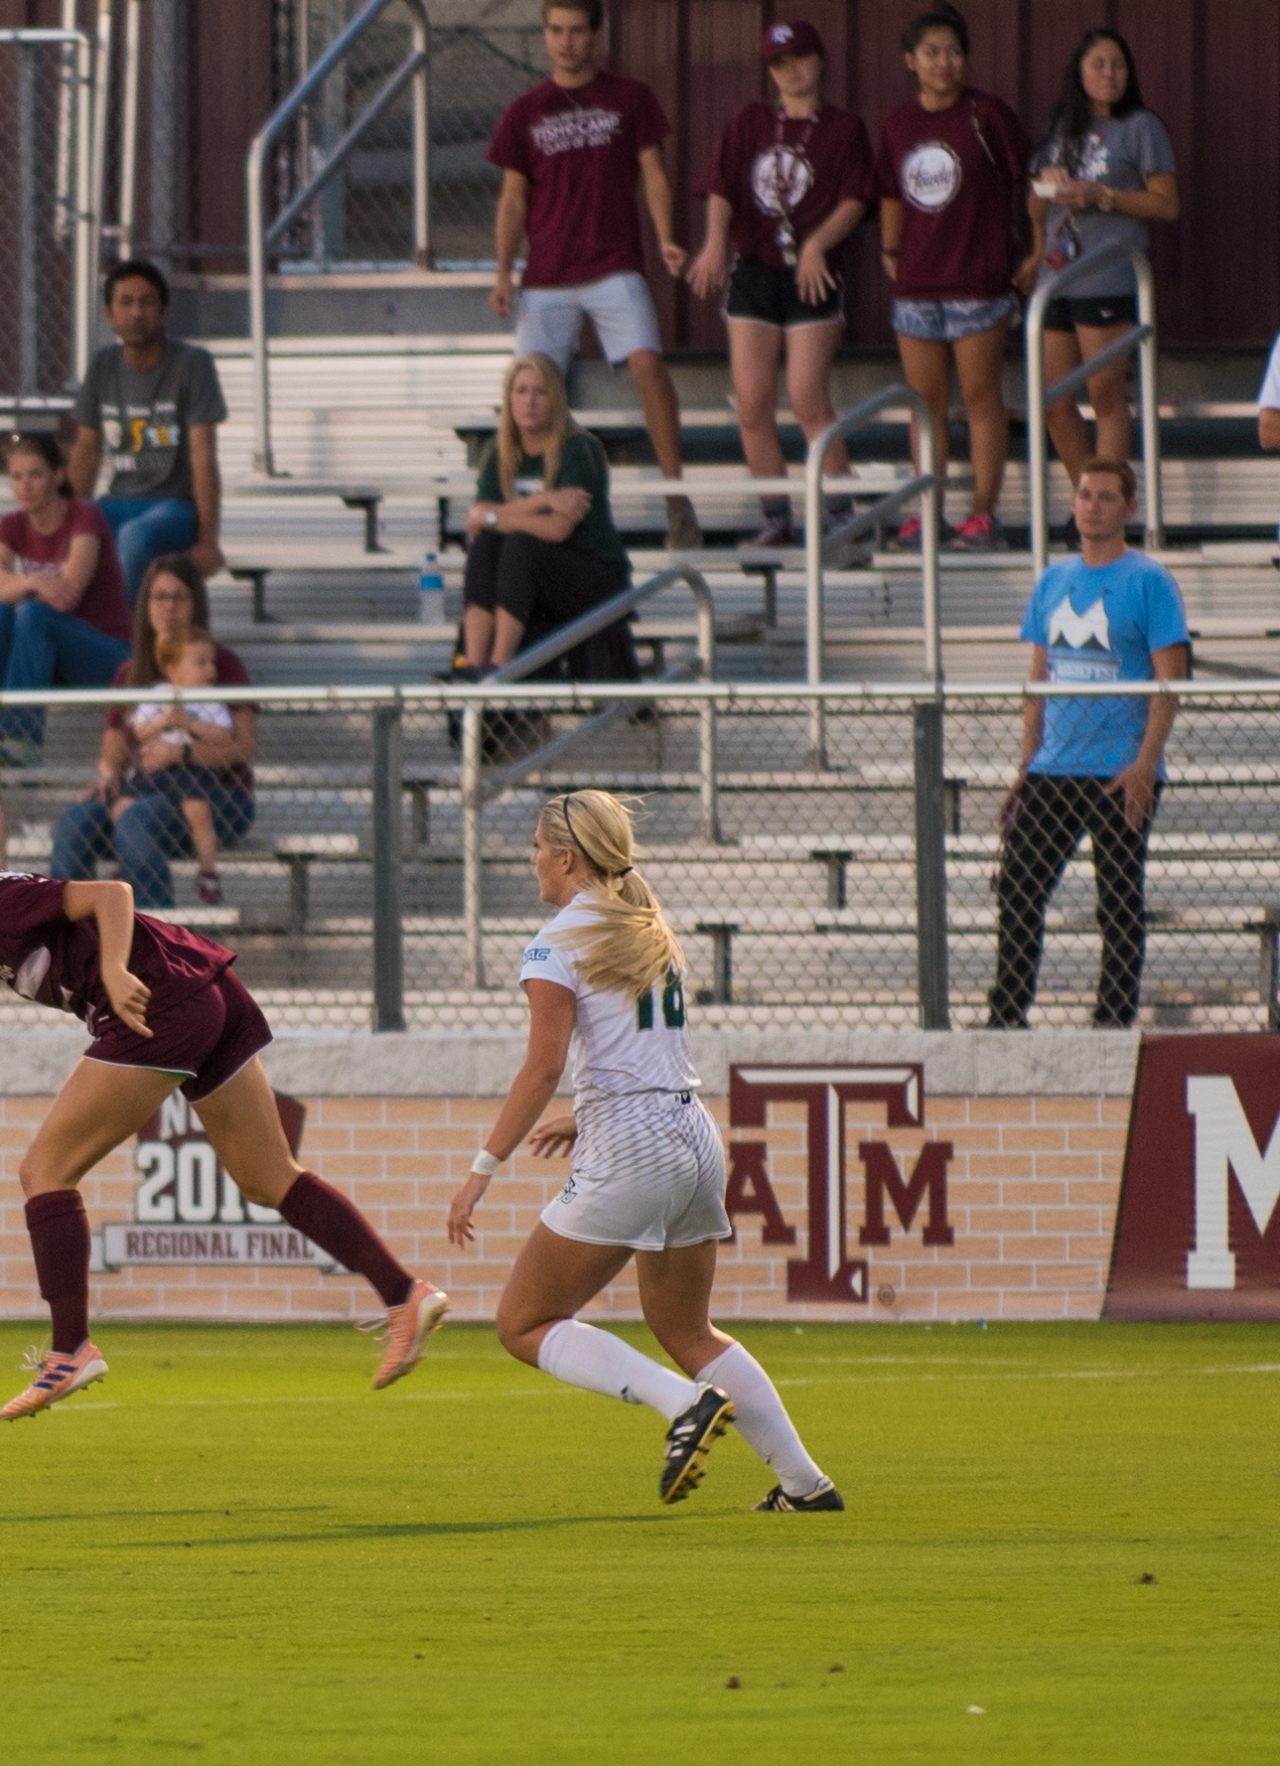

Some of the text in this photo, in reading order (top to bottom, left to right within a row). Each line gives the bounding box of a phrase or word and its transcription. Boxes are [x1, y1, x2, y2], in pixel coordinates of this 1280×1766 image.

[136, 1141, 283, 1223] 201
[126, 1230, 315, 1259] REGIONAL FINAL
